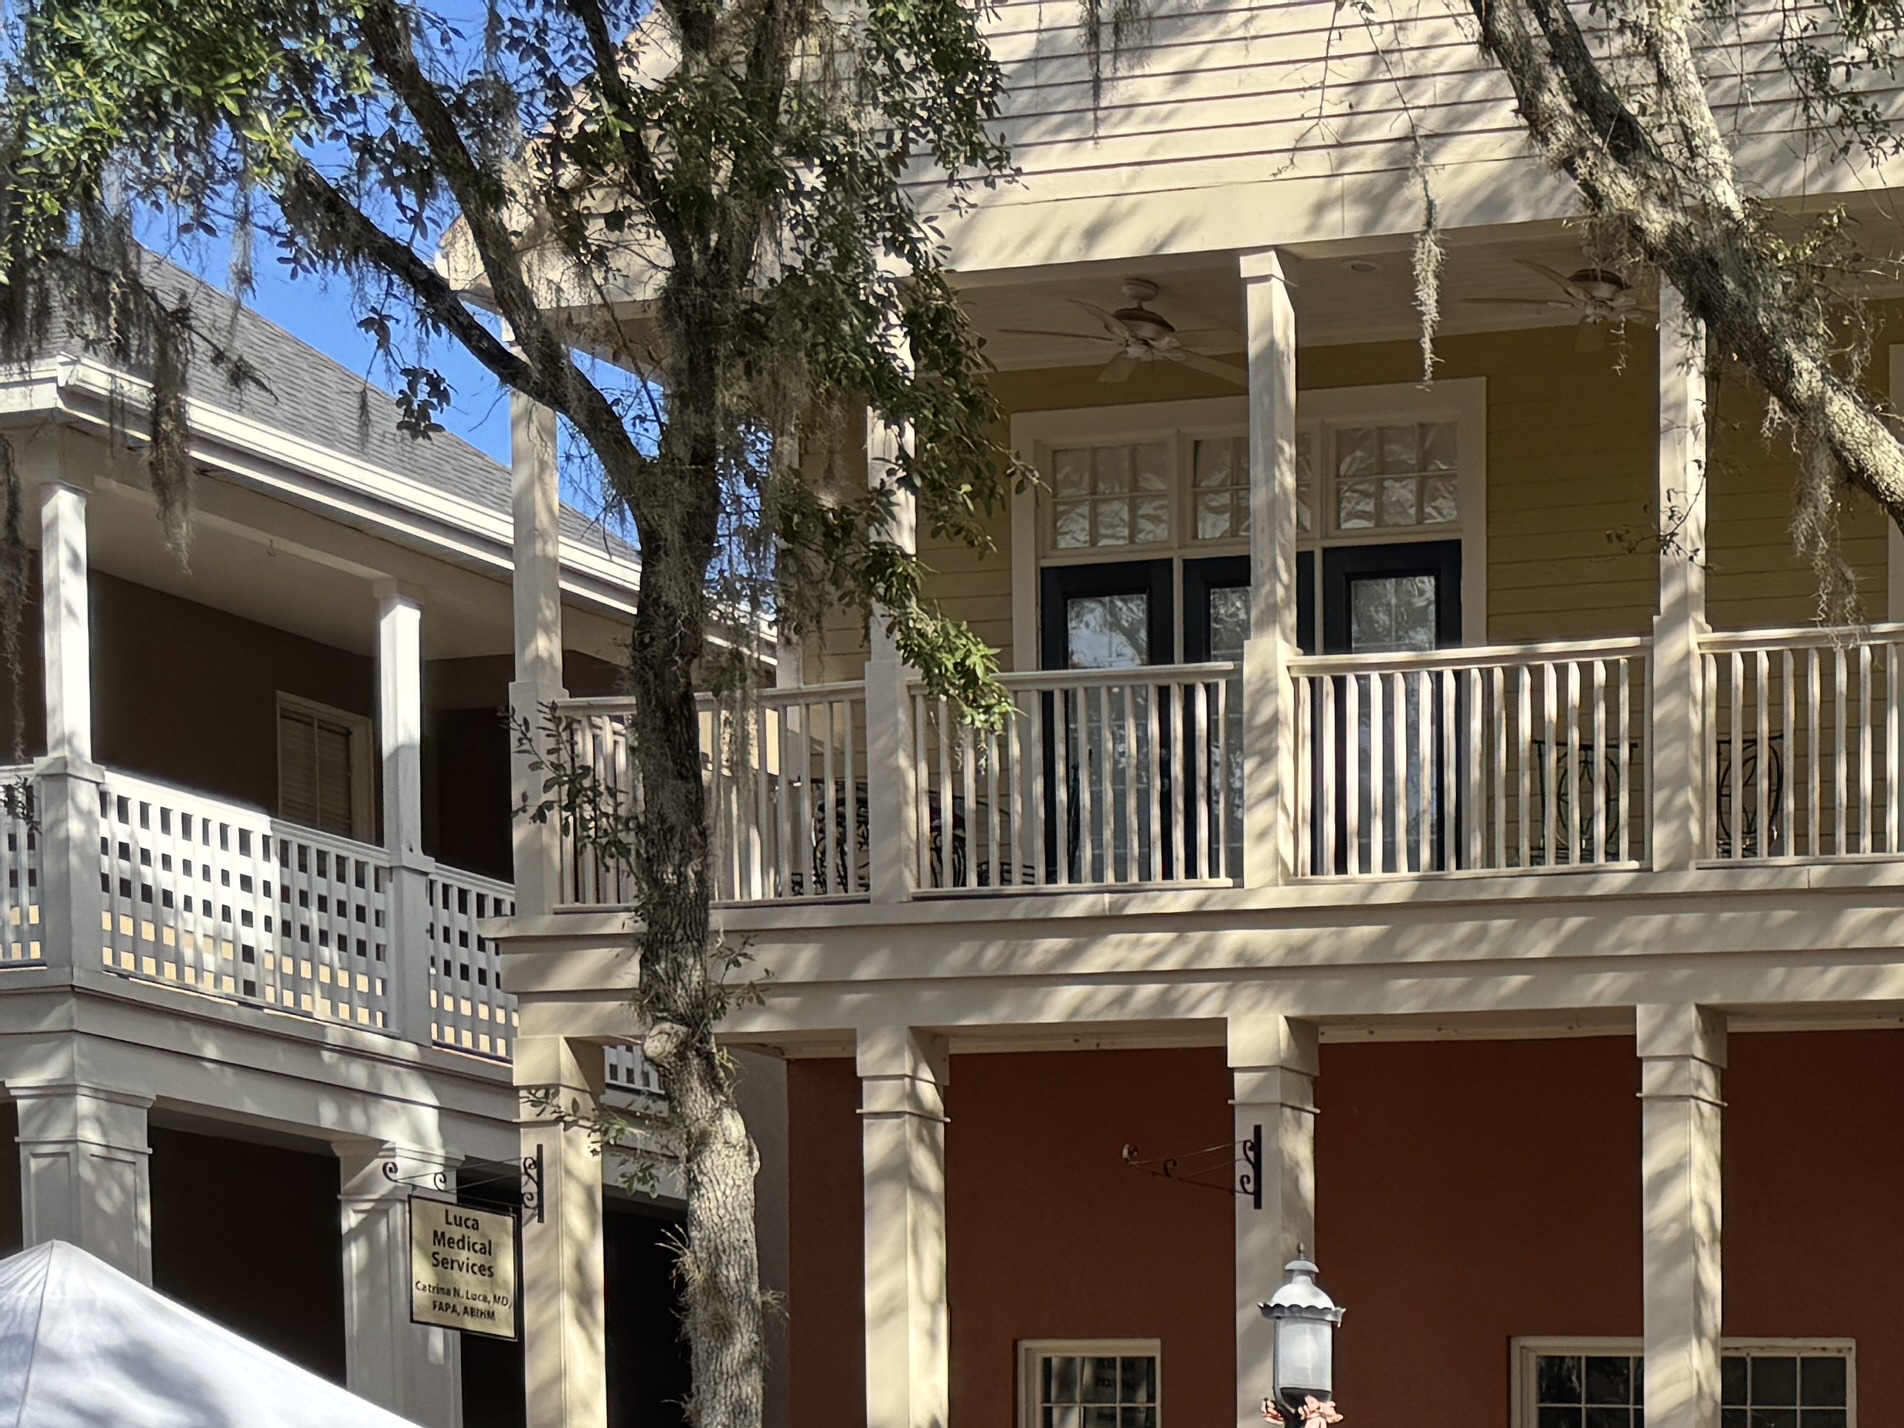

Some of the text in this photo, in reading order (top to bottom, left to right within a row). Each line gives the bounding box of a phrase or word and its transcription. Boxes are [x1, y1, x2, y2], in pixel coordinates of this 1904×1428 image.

[444, 1208, 480, 1231] Luca
[432, 1229, 493, 1257] Medical
[431, 1252, 495, 1278] Services
[432, 1300, 460, 1317] FAPA,
